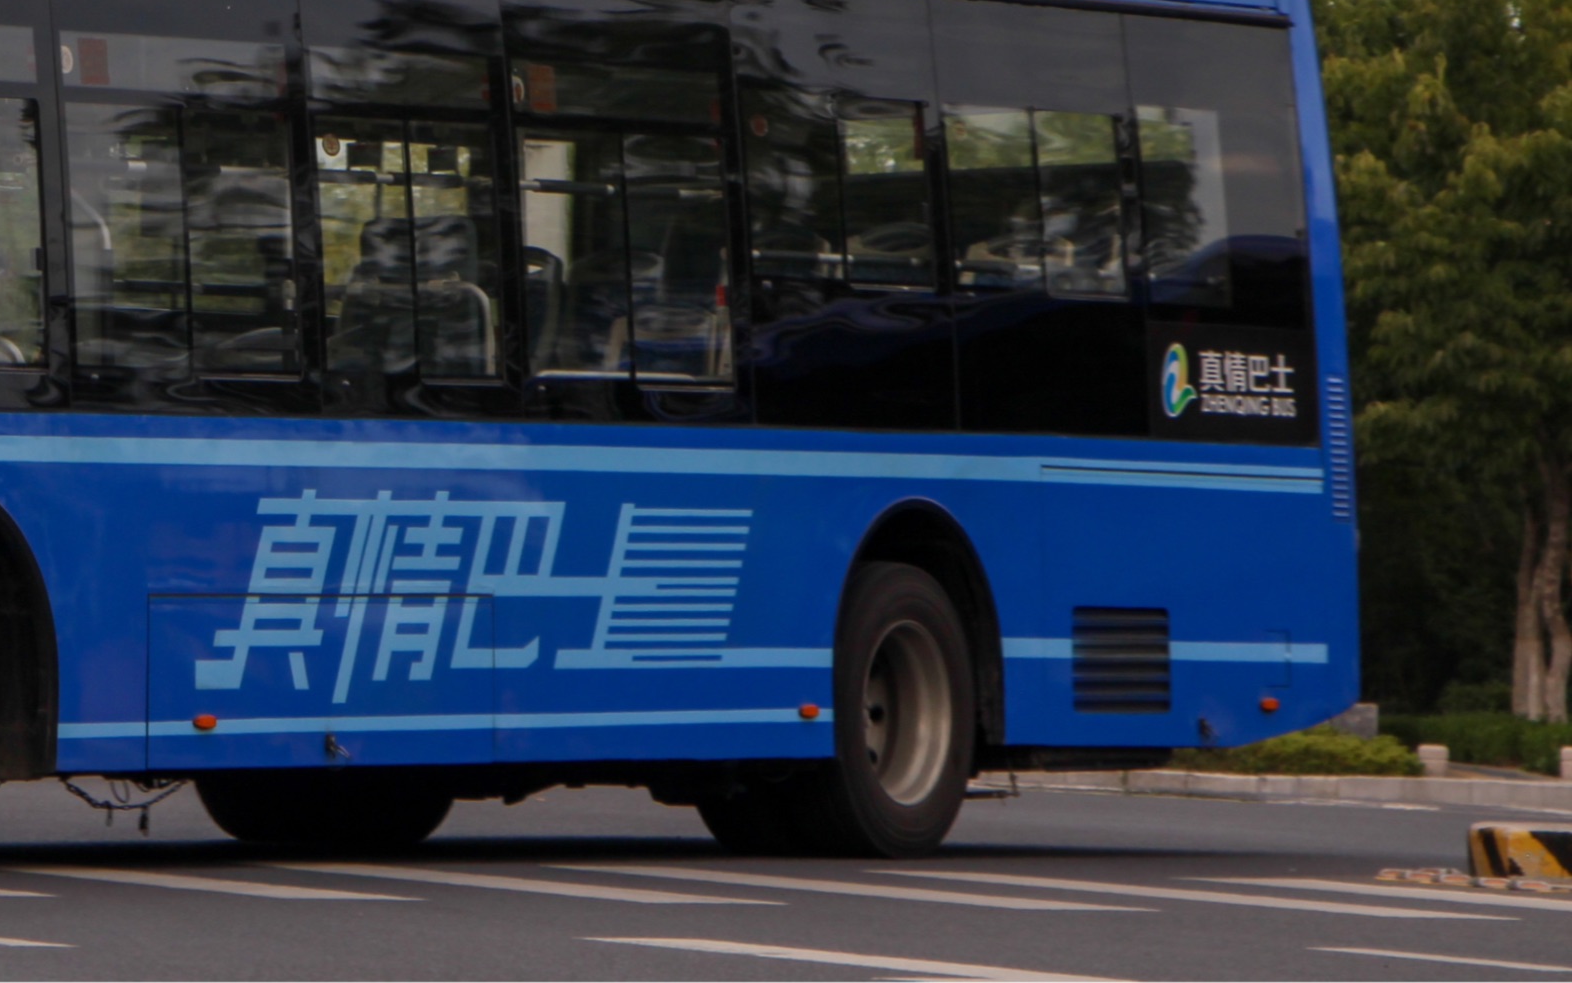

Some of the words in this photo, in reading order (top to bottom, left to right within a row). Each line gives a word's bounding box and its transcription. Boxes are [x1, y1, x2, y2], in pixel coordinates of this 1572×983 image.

[1198, 351, 1295, 393] 真情巴士
[195, 489, 753, 703] 真情巴士
